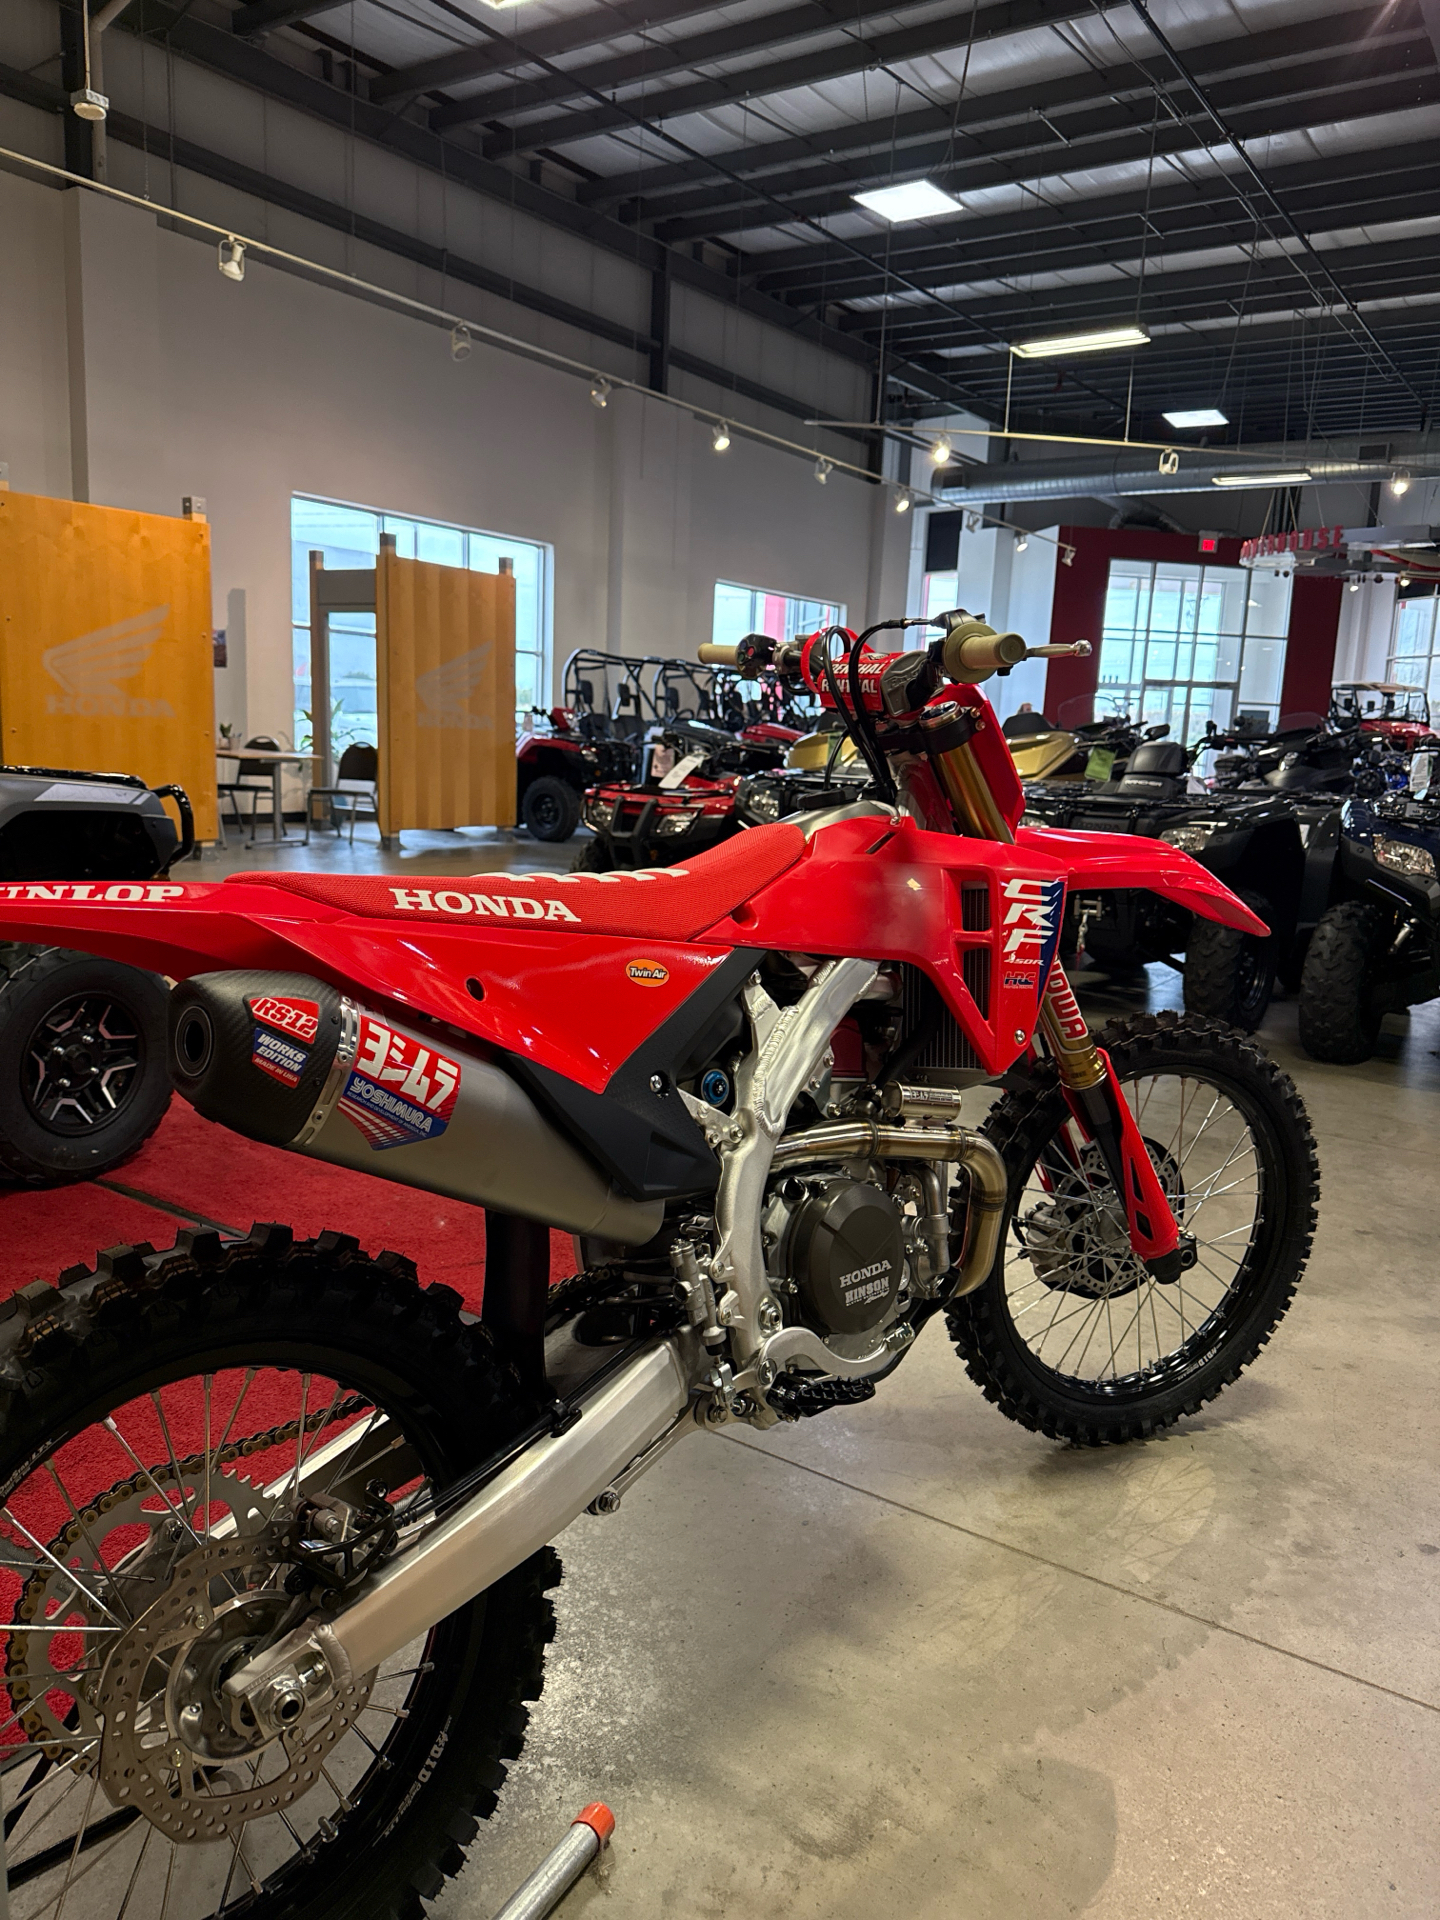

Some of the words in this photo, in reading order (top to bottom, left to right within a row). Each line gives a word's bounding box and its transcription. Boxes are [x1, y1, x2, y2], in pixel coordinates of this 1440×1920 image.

[45, 695, 176, 718] HONDA
[417, 711, 495, 729] HONDA
[388, 888, 582, 922] HONDA
[1003, 878, 1057, 953] CRF
[630, 967, 651, 977] Twin
[652, 969, 667, 979] Air
[256, 1046, 302, 1072] EDITION
[257, 1034, 306, 1063] WORKS
[254, 1057, 277, 1072] MADE
[275, 1067, 284, 1075] IN
[283, 1071, 298, 1082] USA
[350, 1077, 433, 1132] YOSHIMURA
[839, 1260, 892, 1288] HONDA
[845, 1276, 889, 1304] HINSON
